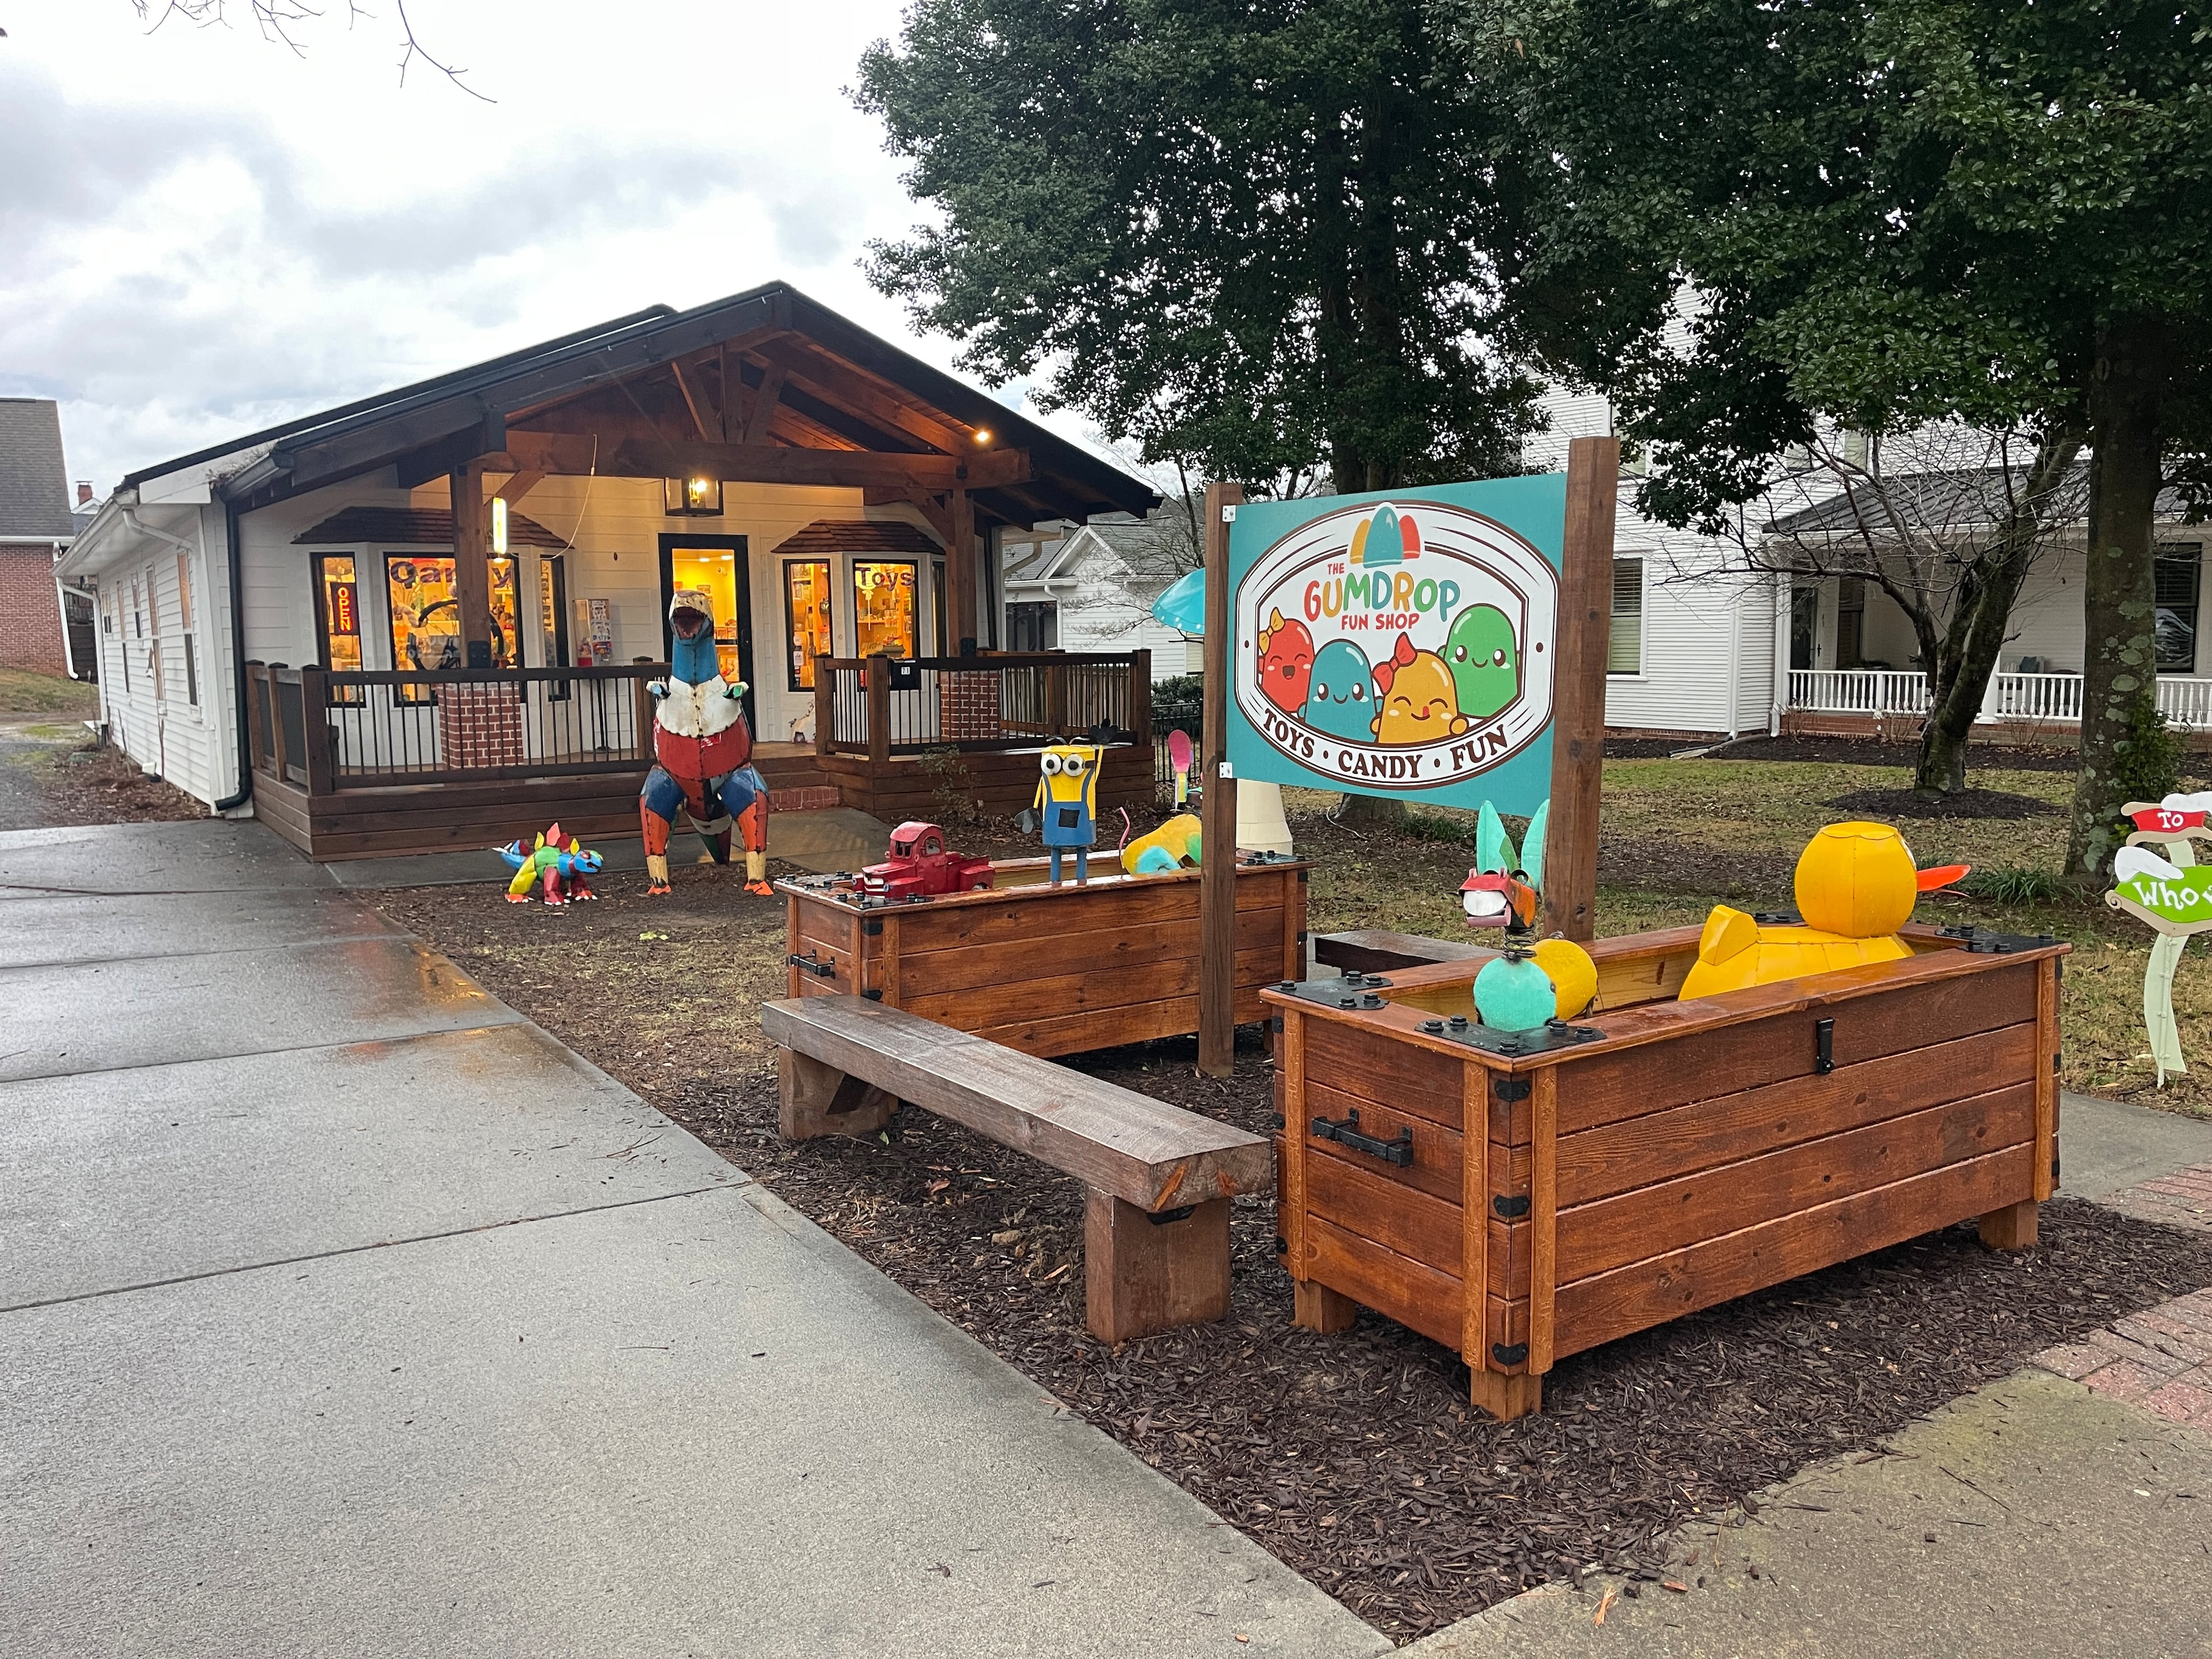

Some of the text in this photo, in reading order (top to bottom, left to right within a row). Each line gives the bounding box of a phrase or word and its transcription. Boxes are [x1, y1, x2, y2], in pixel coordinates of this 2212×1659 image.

[855, 567, 914, 592] Toys
[1327, 562, 1345, 575] THE
[338, 586, 352, 631] OPEN
[1304, 570, 1461, 622] GUMDROP
[1341, 613, 1420, 631] FUN SHOP
[1263, 707, 1508, 779] TOYS CANDY FUN
